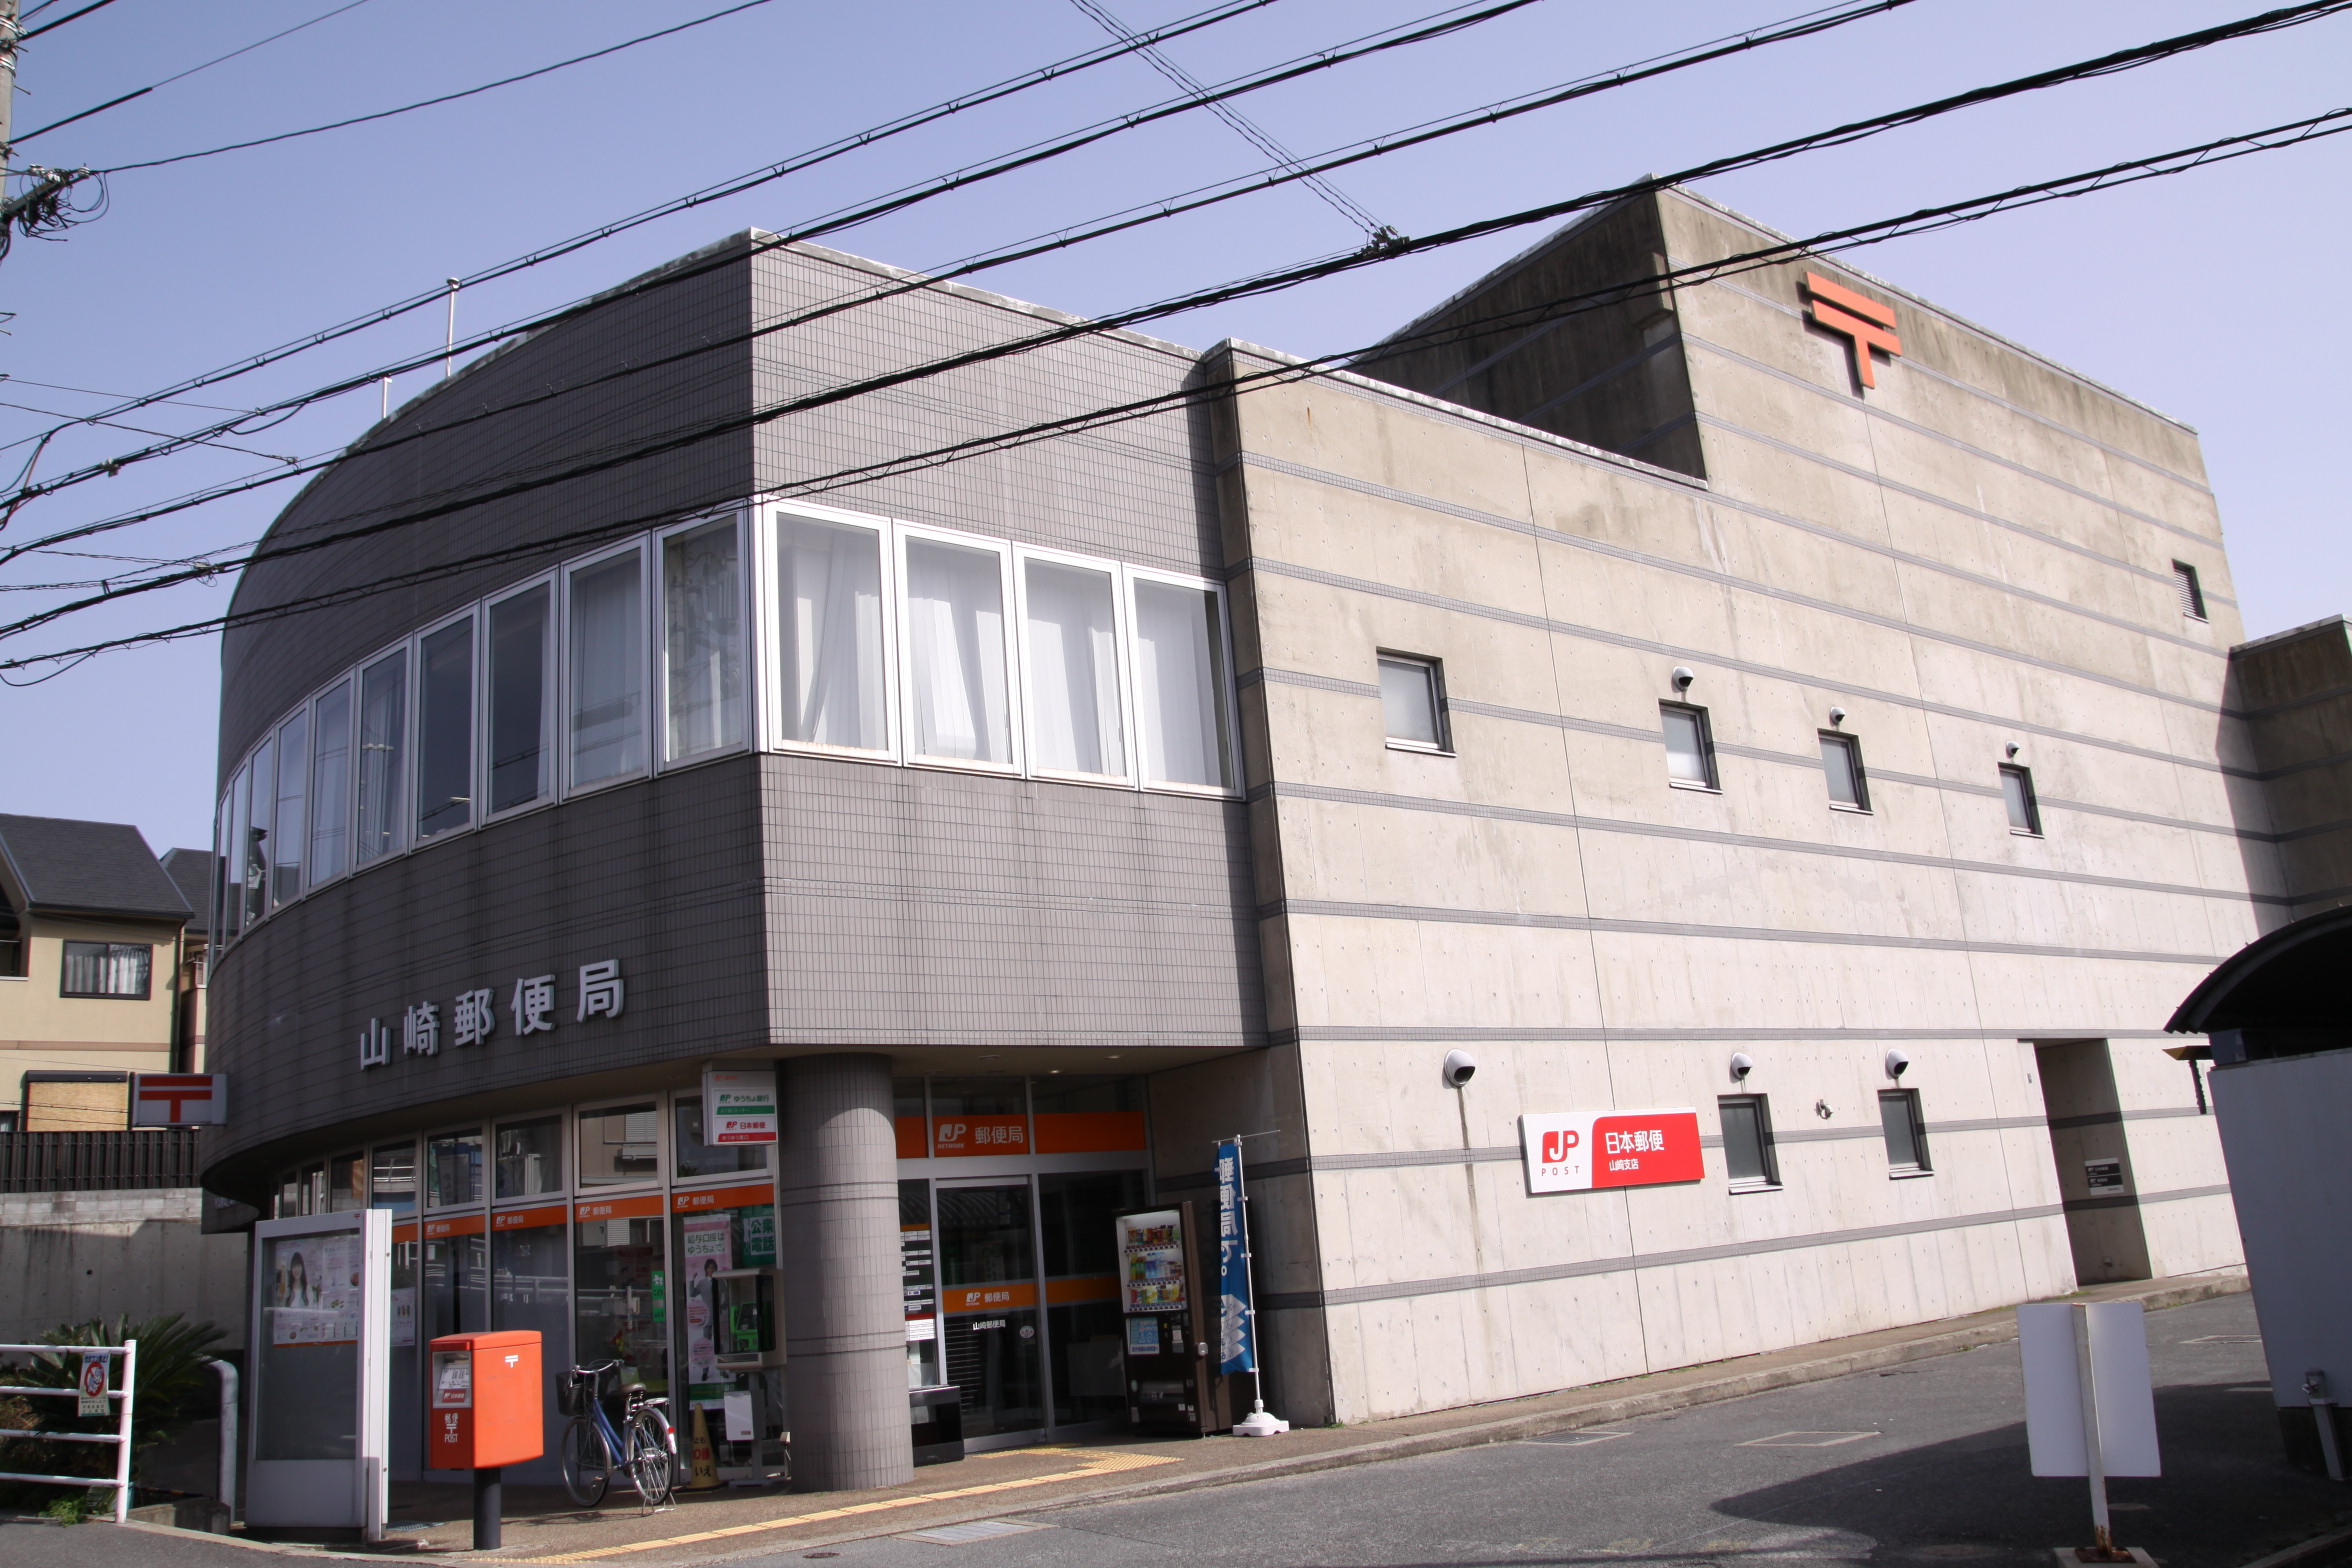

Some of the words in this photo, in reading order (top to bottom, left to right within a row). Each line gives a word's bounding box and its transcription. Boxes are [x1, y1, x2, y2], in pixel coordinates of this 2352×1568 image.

[360, 959, 625, 1070] 山崎郵便局
[740, 1121, 766, 1129] 日本郵便
[974, 1126, 1024, 1144] 郵便局
[1542, 1130, 1580, 1164] JP
[1605, 1129, 1665, 1154] 日本郵便
[1609, 1158, 1639, 1171] 山崎支店
[1541, 1166, 1580, 1176] POST
[751, 1218, 774, 1234] 公衆
[687, 1232, 725, 1244] 給与口座は
[751, 1236, 775, 1252] 電話
[984, 1291, 1010, 1303] 郵便局
[972, 1319, 1006, 1331] 山崎郵便局
[444, 1413, 458, 1424] 郵便
[444, 1434, 458, 1443] POST
